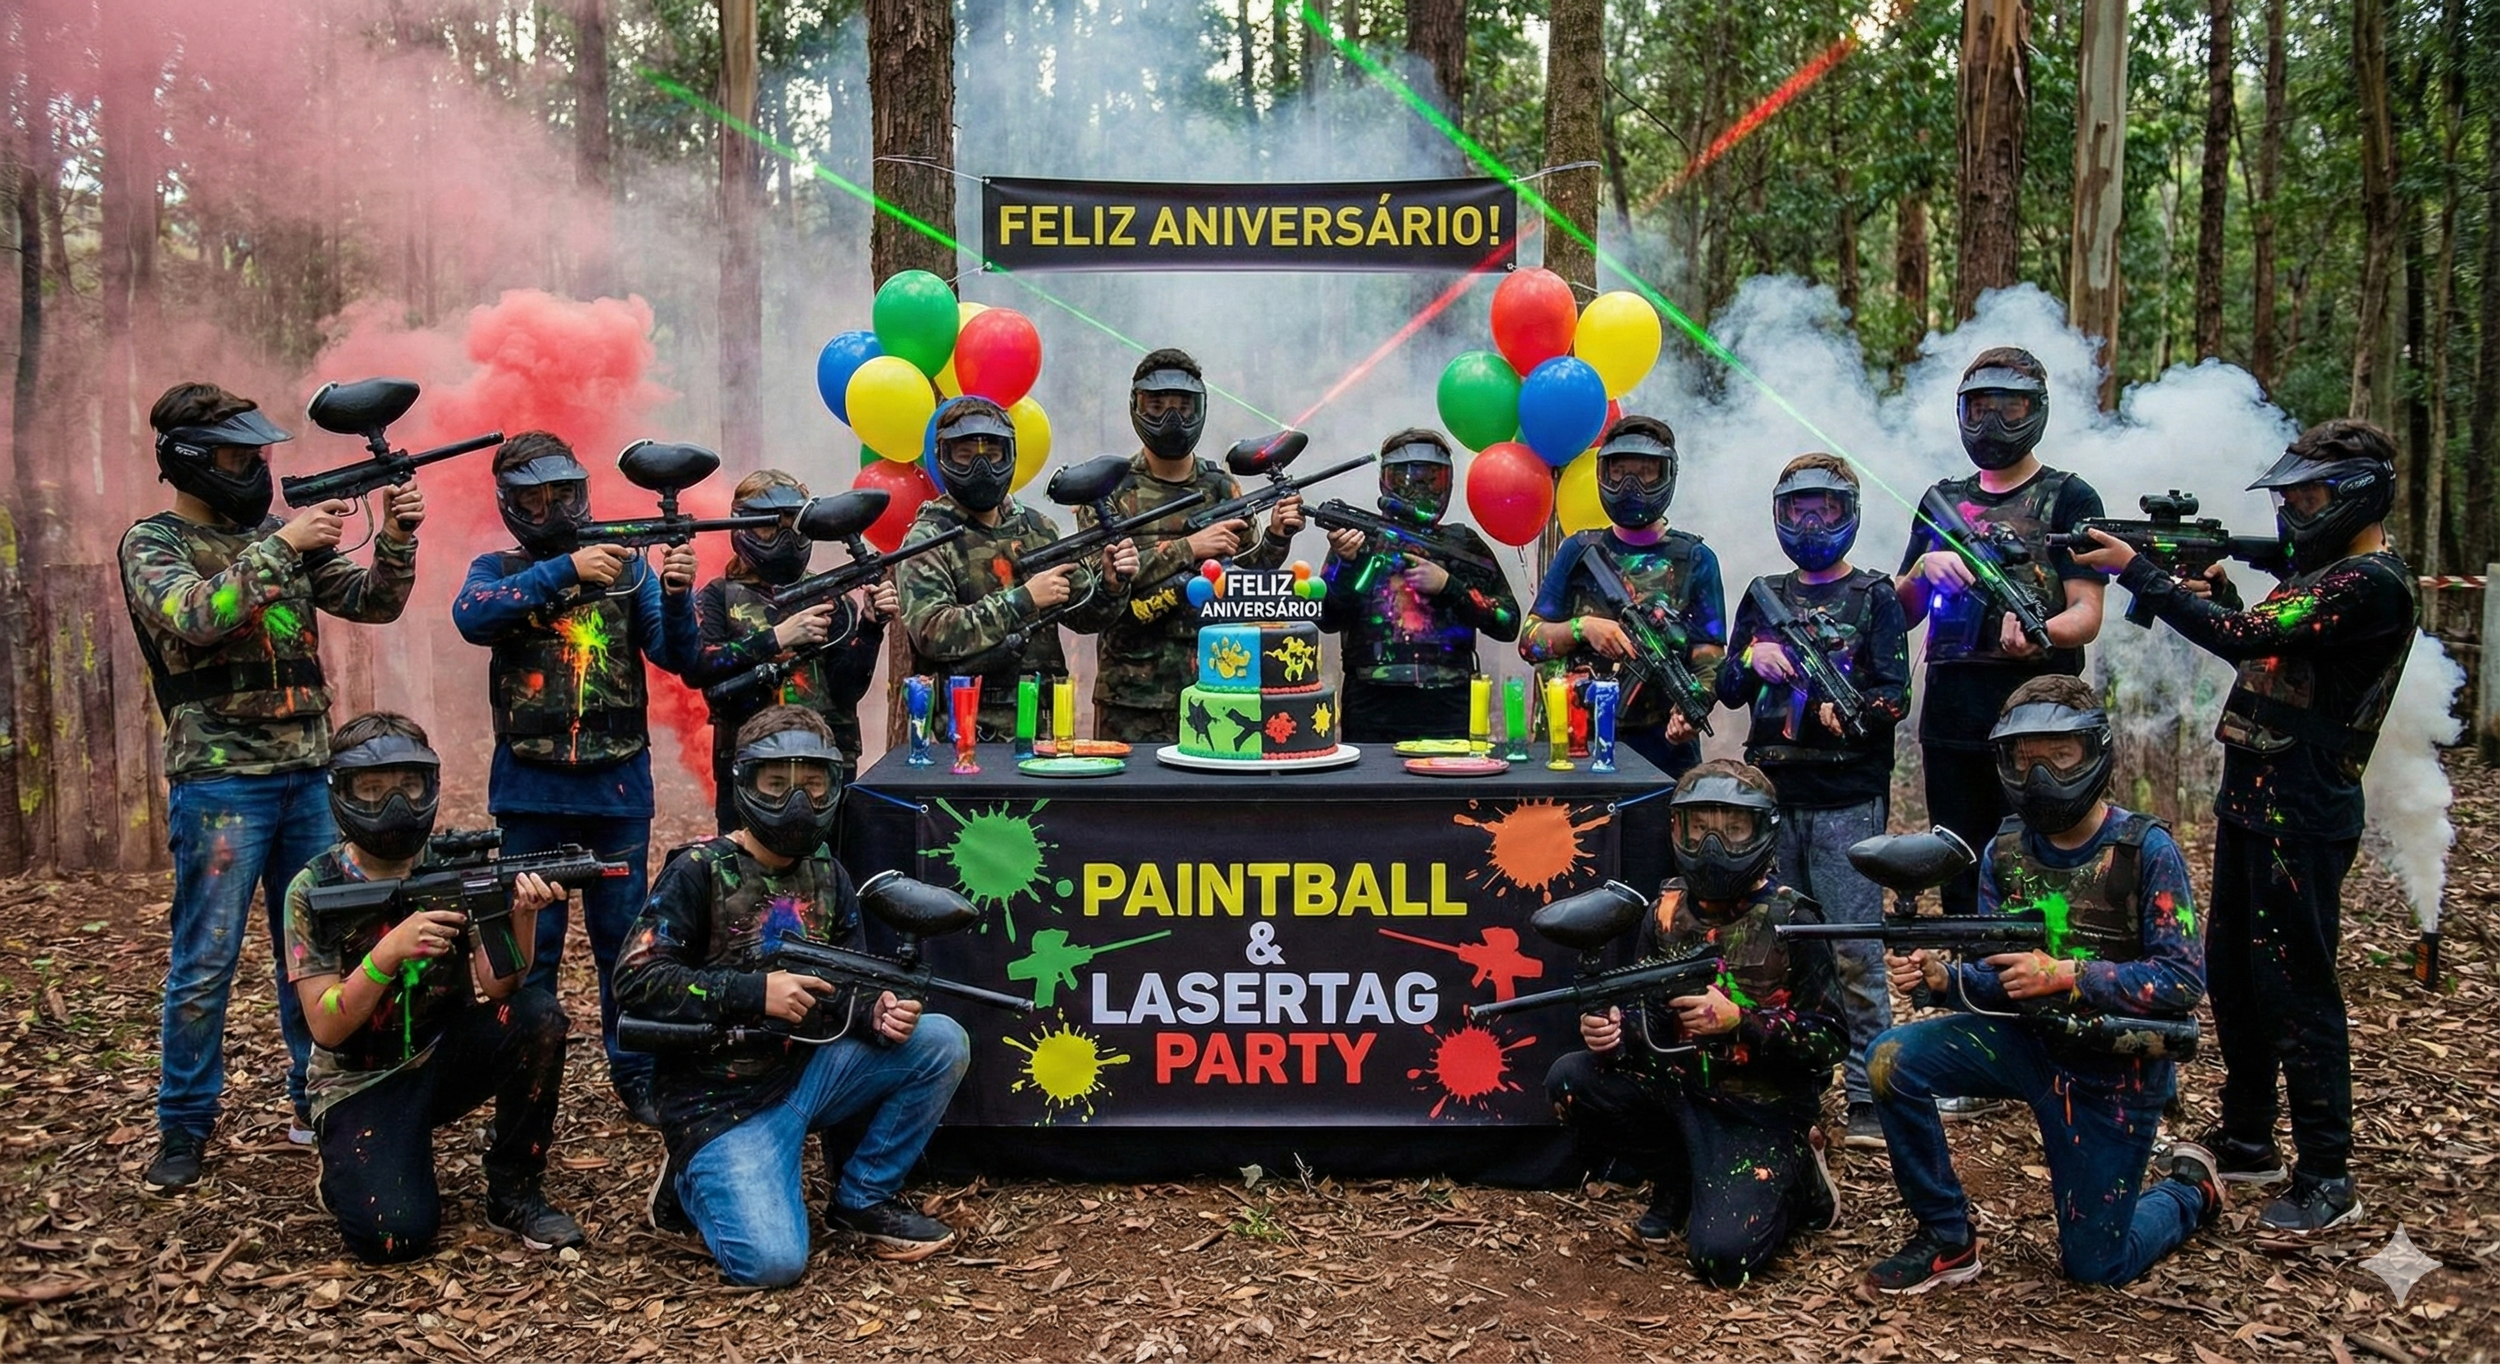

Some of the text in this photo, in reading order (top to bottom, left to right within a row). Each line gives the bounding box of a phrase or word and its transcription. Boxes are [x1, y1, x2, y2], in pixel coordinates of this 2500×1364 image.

[999, 193, 1501, 246] FELIZ ANIVERSÁRIO!
[1200, 598, 1322, 617] ANIVERSÁRIO!
[1227, 574, 1293, 596] FELIZ
[1083, 863, 1468, 916] PAINTBALL
[1245, 921, 1286, 965] &
[1091, 972, 1439, 1025] LASERTAG
[1156, 1032, 1377, 1084] PARTY
